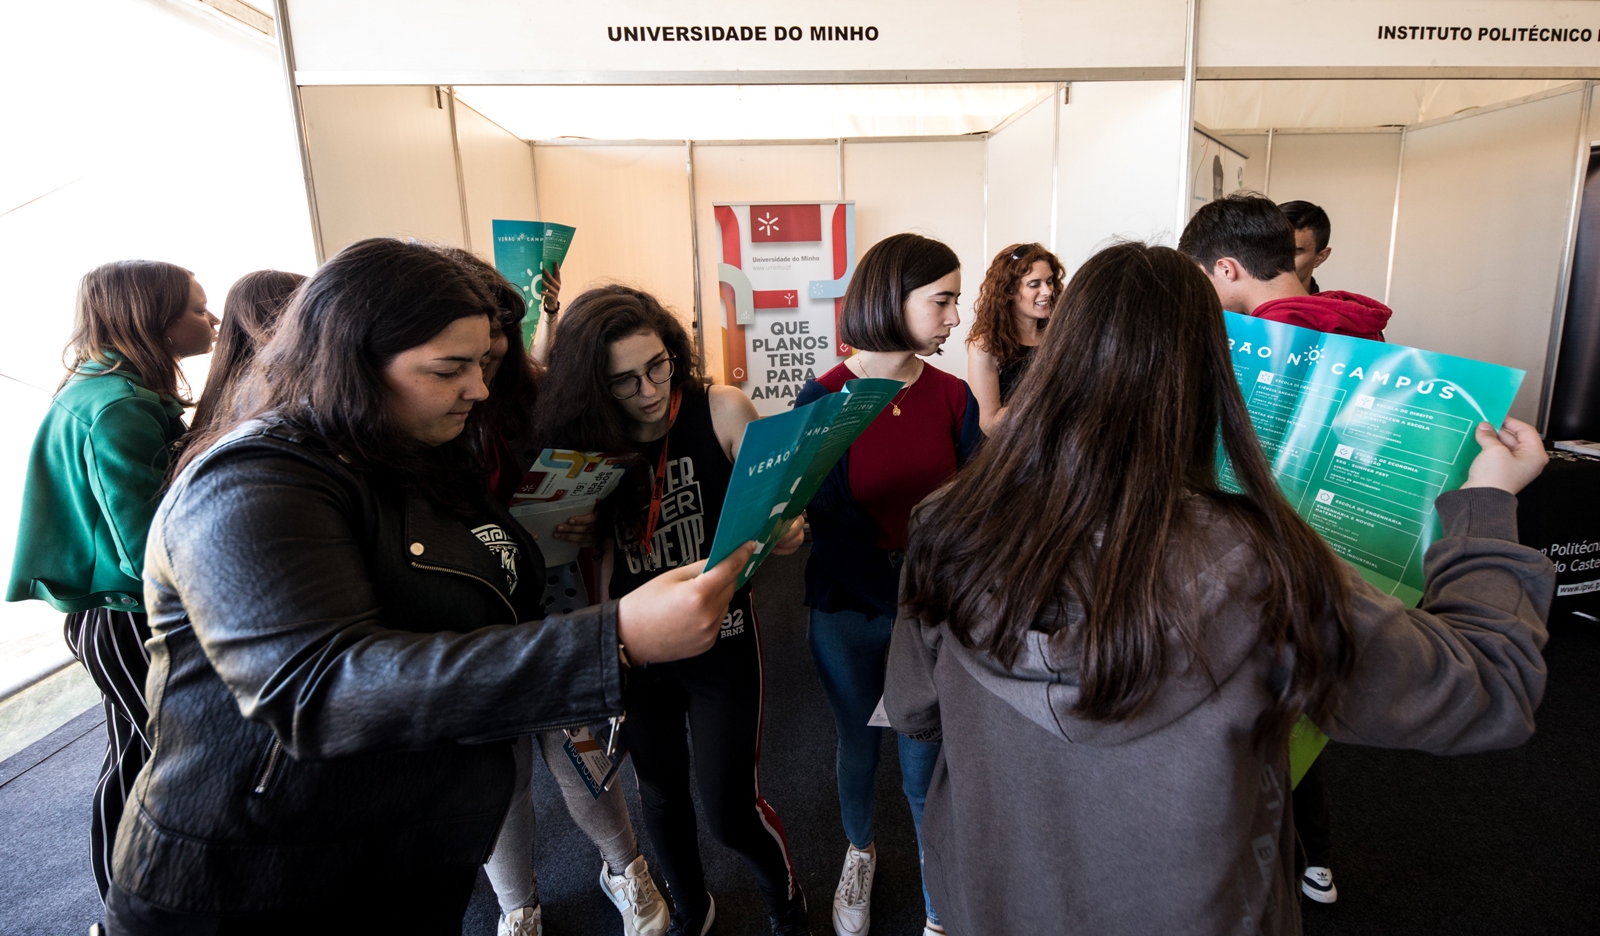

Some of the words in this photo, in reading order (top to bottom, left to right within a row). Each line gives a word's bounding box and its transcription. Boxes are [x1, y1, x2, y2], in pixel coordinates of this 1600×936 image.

[607, 26, 767, 41] UNIVERSIDADE
[774, 26, 803, 41] DO
[810, 26, 879, 41] MINHO
[1377, 26, 1472, 40] INSTITUTO
[1478, 25, 1592, 42] POLITÉCNICO
[770, 321, 810, 335] QUE
[752, 336, 829, 352] PLANOS
[767, 352, 816, 367] TENS
[766, 368, 817, 383] PARA
[1228, 338, 1272, 358] RÃO
[1331, 363, 1456, 399] CAMPUS
[751, 383, 804, 400] AMAN
[1376, 403, 1399, 412] ESCOLA
[1409, 410, 1434, 420] DIREITO
[1407, 421, 1430, 431] ESCOLA
[1355, 452, 1377, 461] ESCOLA
[1387, 460, 1418, 473] ECONOMIA
[1375, 470, 1389, 478] FEST
[1316, 504, 1350, 519] ENGENHARIA
[1355, 518, 1375, 528] NOVOS
[1335, 499, 1356, 510] ESCOLA
[1365, 510, 1402, 526] ENGENHARIA
[1550, 540, 1600, 556] Politécn
[1570, 558, 1600, 572] Caste
[1560, 582, 1600, 593] www.ipvc.p
[720, 625, 745, 638] BRNX
